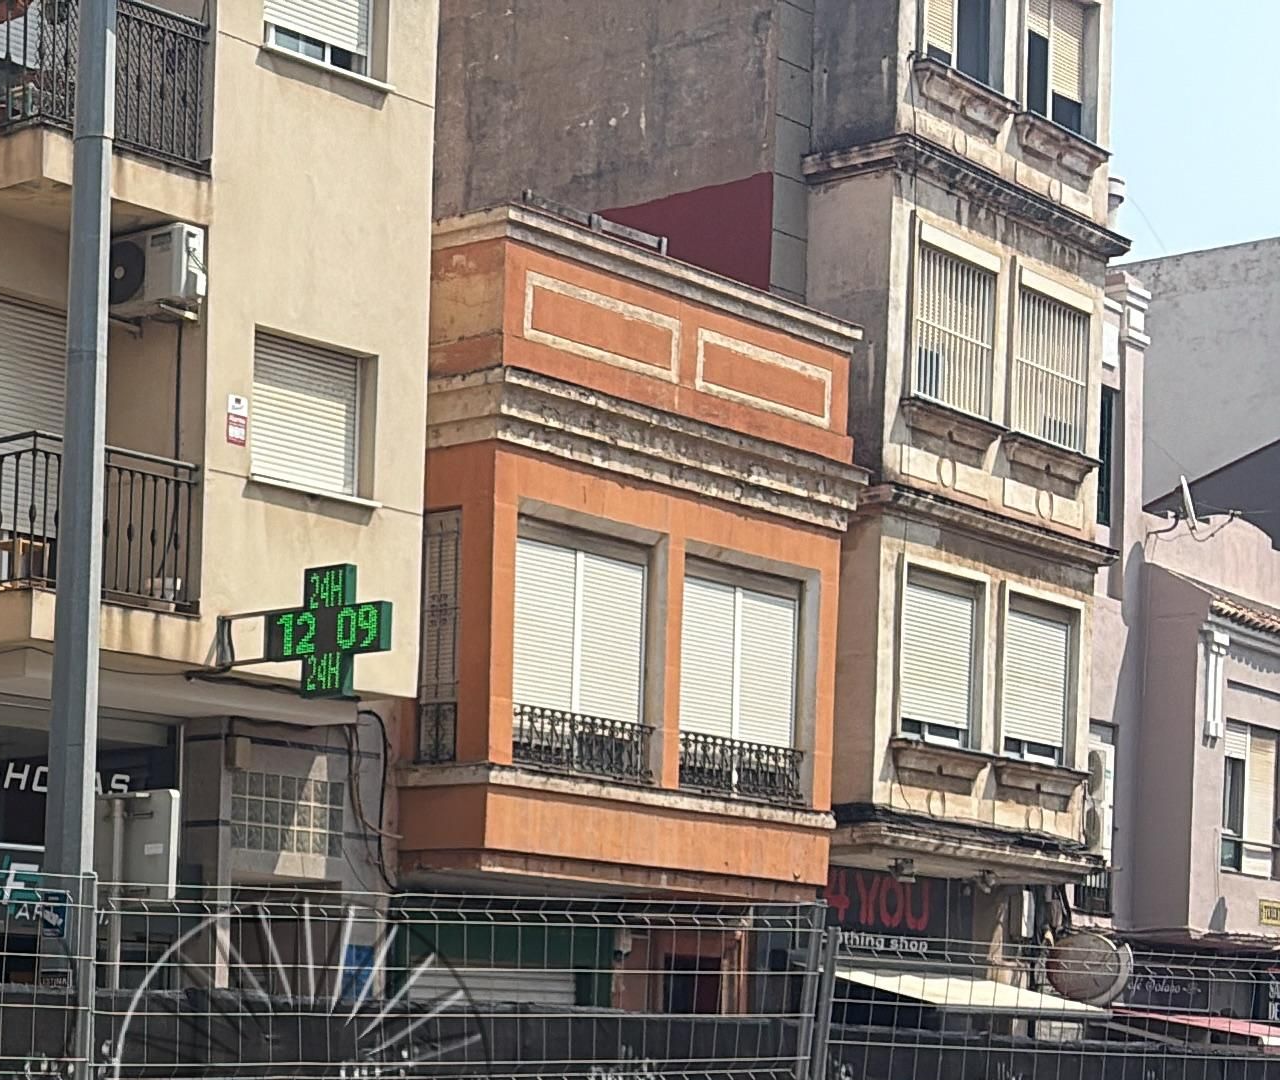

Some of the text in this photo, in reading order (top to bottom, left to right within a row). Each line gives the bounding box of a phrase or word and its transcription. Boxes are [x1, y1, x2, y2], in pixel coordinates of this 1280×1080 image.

[308, 569, 343, 610] 24H
[306, 651, 341, 691] 24H
[3, 761, 130, 795] HOS
[890, 936, 929, 953] shop
